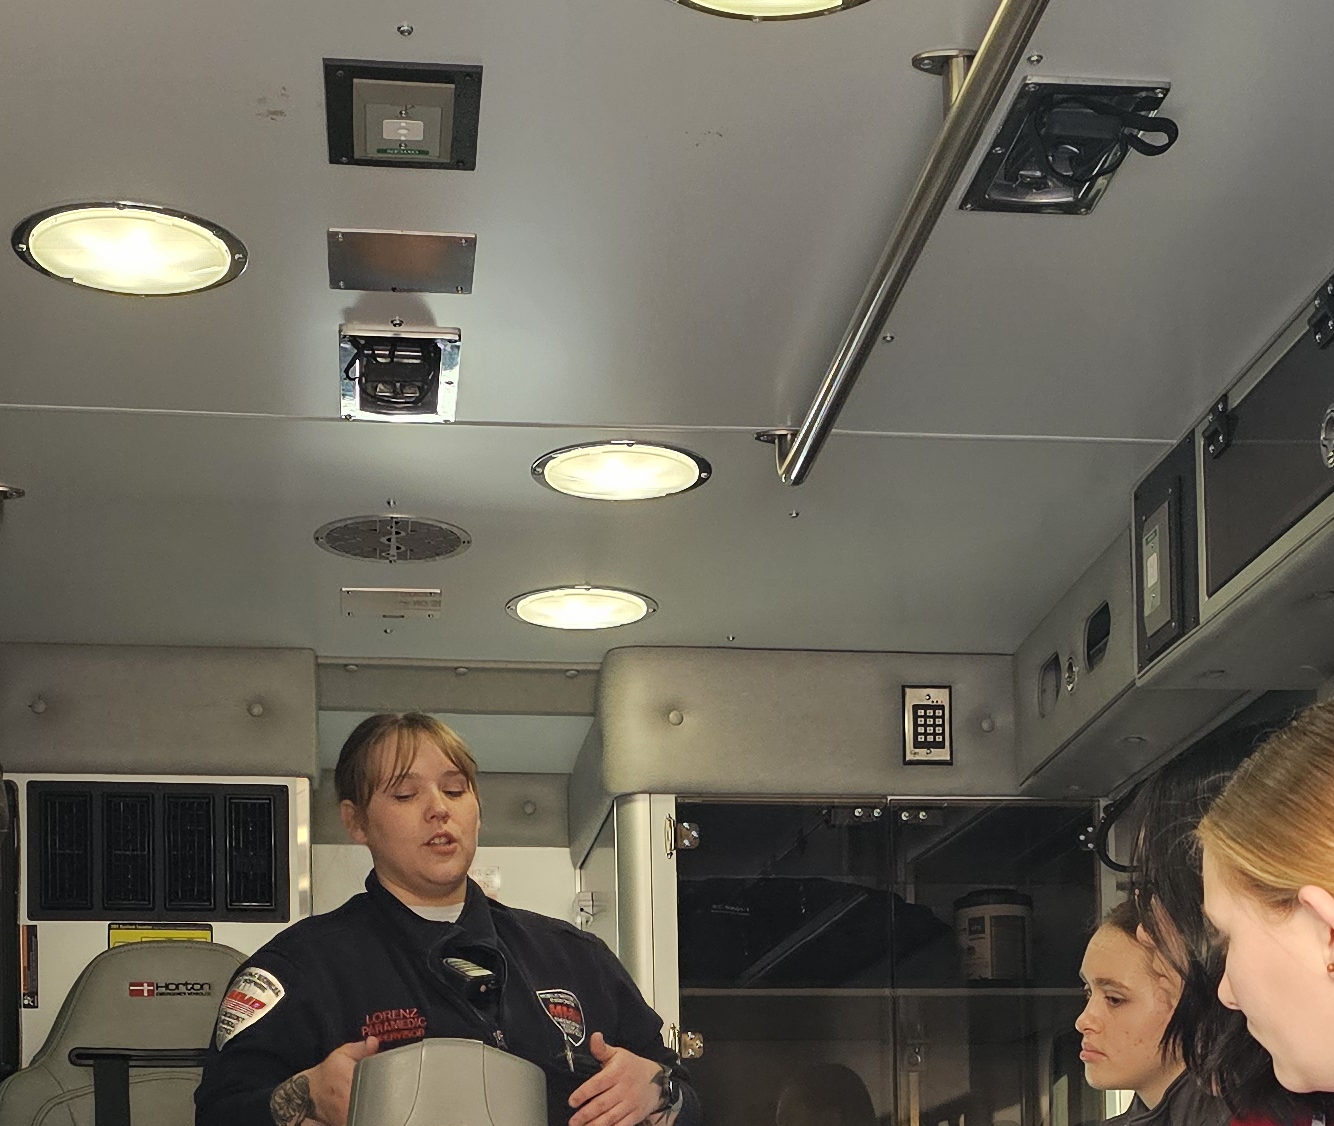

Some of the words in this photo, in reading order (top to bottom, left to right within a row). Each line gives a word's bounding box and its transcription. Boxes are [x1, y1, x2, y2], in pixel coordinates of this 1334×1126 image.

[156, 980, 211, 992] Horton
[365, 1007, 419, 1025] LORENZ
[361, 1016, 427, 1037] PARAMEDIC
